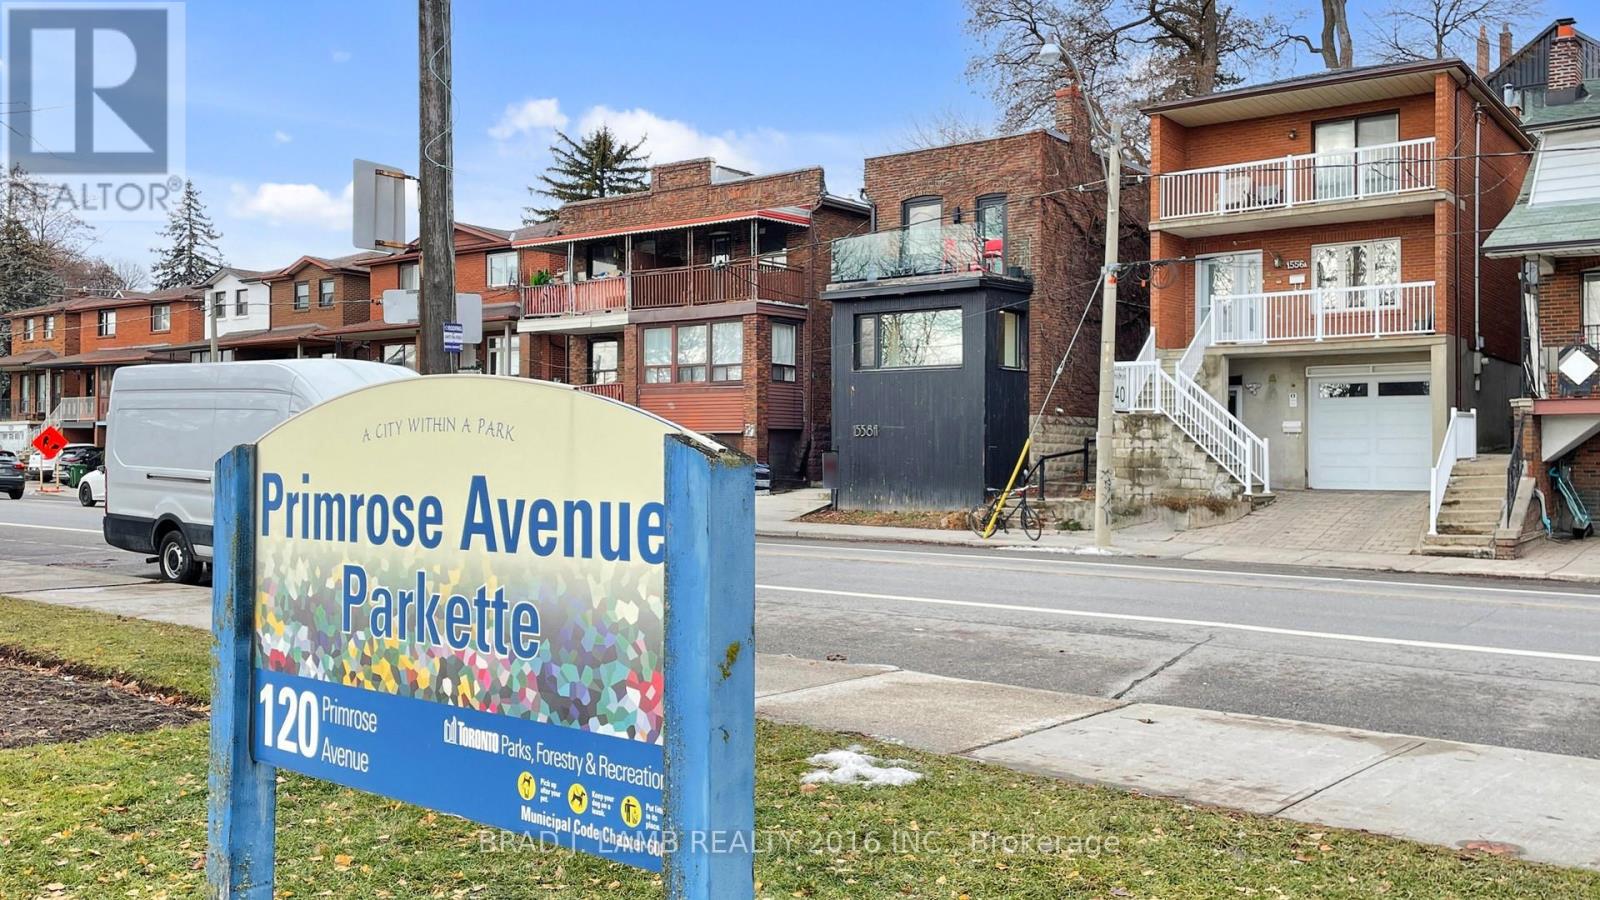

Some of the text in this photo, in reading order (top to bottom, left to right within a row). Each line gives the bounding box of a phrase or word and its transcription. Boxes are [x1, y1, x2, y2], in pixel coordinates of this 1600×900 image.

[1115, 386, 1126, 402] 40
[362, 417, 514, 442] A CITY WITHIN A PARK
[262, 472, 665, 564] Primrose Avenue
[341, 565, 541, 660] Parkette
[260, 683, 319, 758] 120
[322, 696, 377, 733] Primrose
[321, 736, 369, 773] Avenue
[458, 721, 499, 754] TORONTO
[501, 734, 534, 764] Parks,
[536, 742, 583, 776] Forestry
[585, 752, 597, 775] &
[521, 805, 571, 833] Municipal
[573, 819, 599, 841] Code
[602, 827, 645, 854] Chapter
